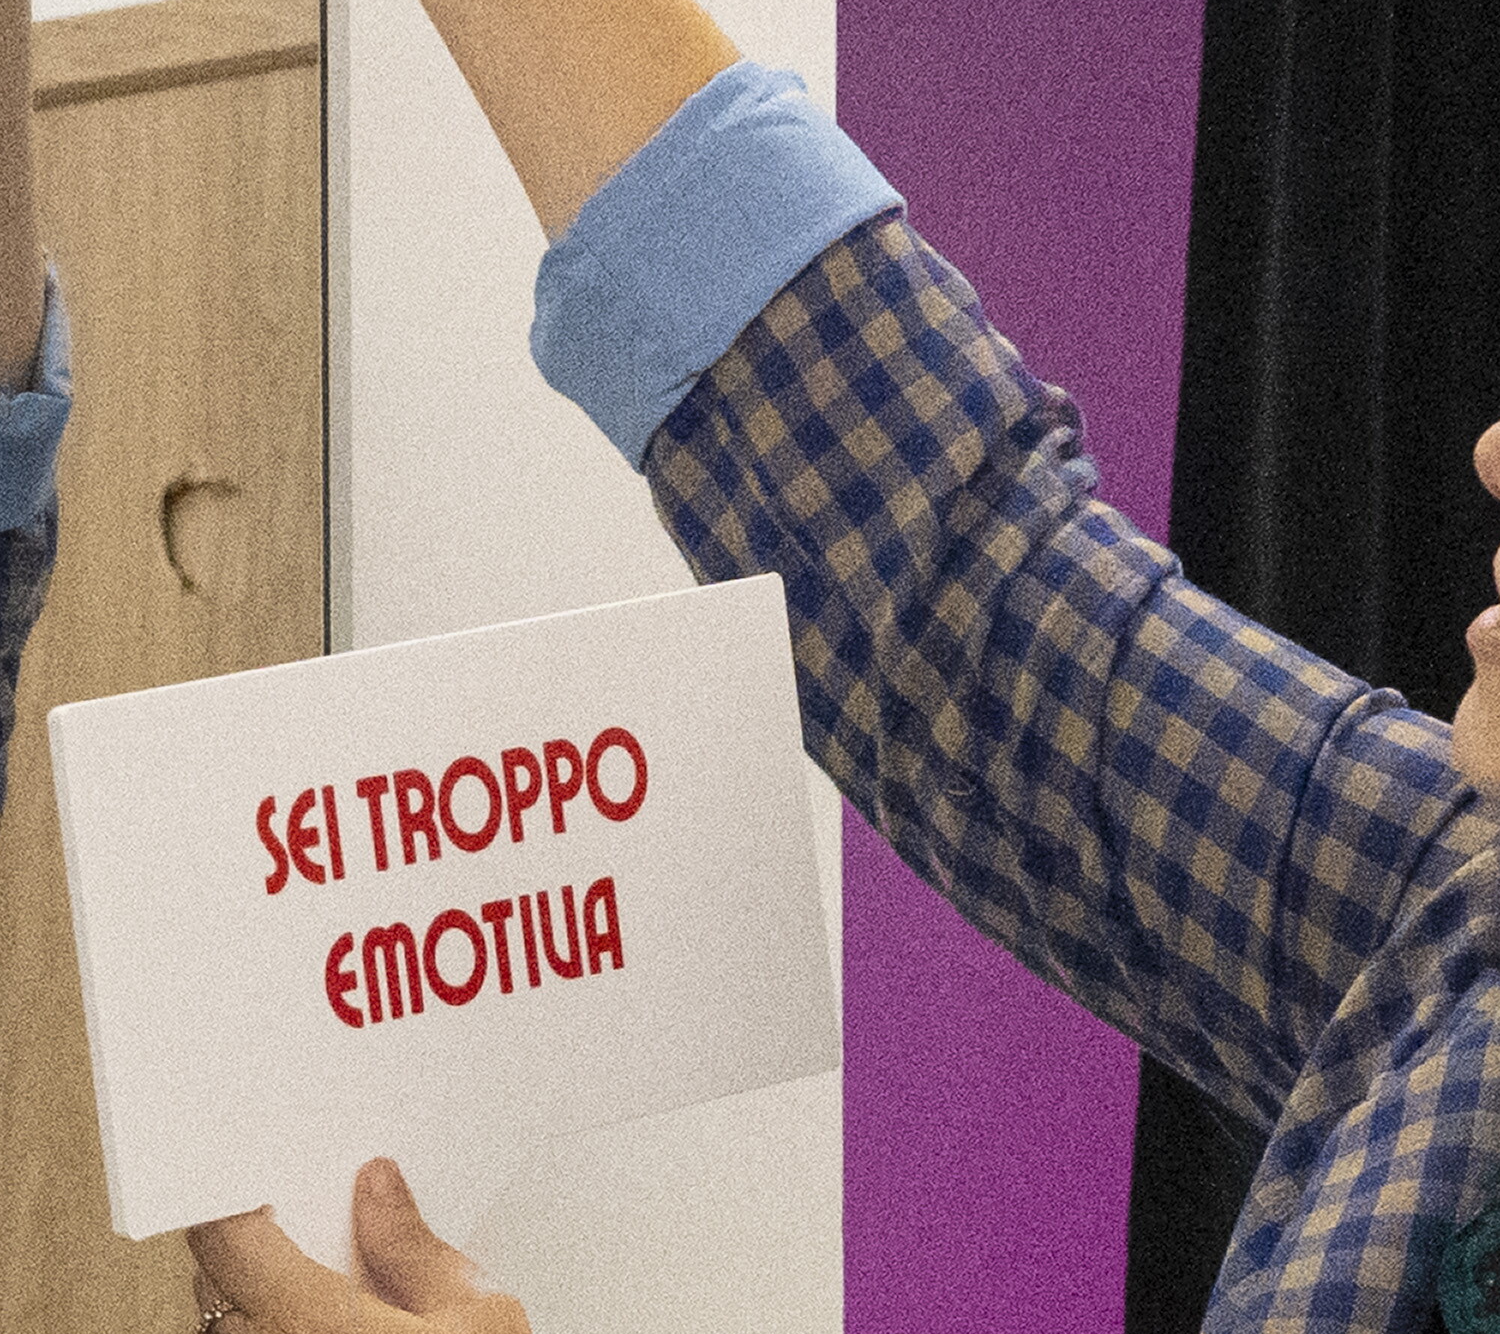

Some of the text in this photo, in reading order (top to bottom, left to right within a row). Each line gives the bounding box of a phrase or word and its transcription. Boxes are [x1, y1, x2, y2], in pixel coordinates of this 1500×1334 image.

[257, 728, 647, 895] SEI TROPPO
[325, 877, 623, 1028] EMOTIVA
